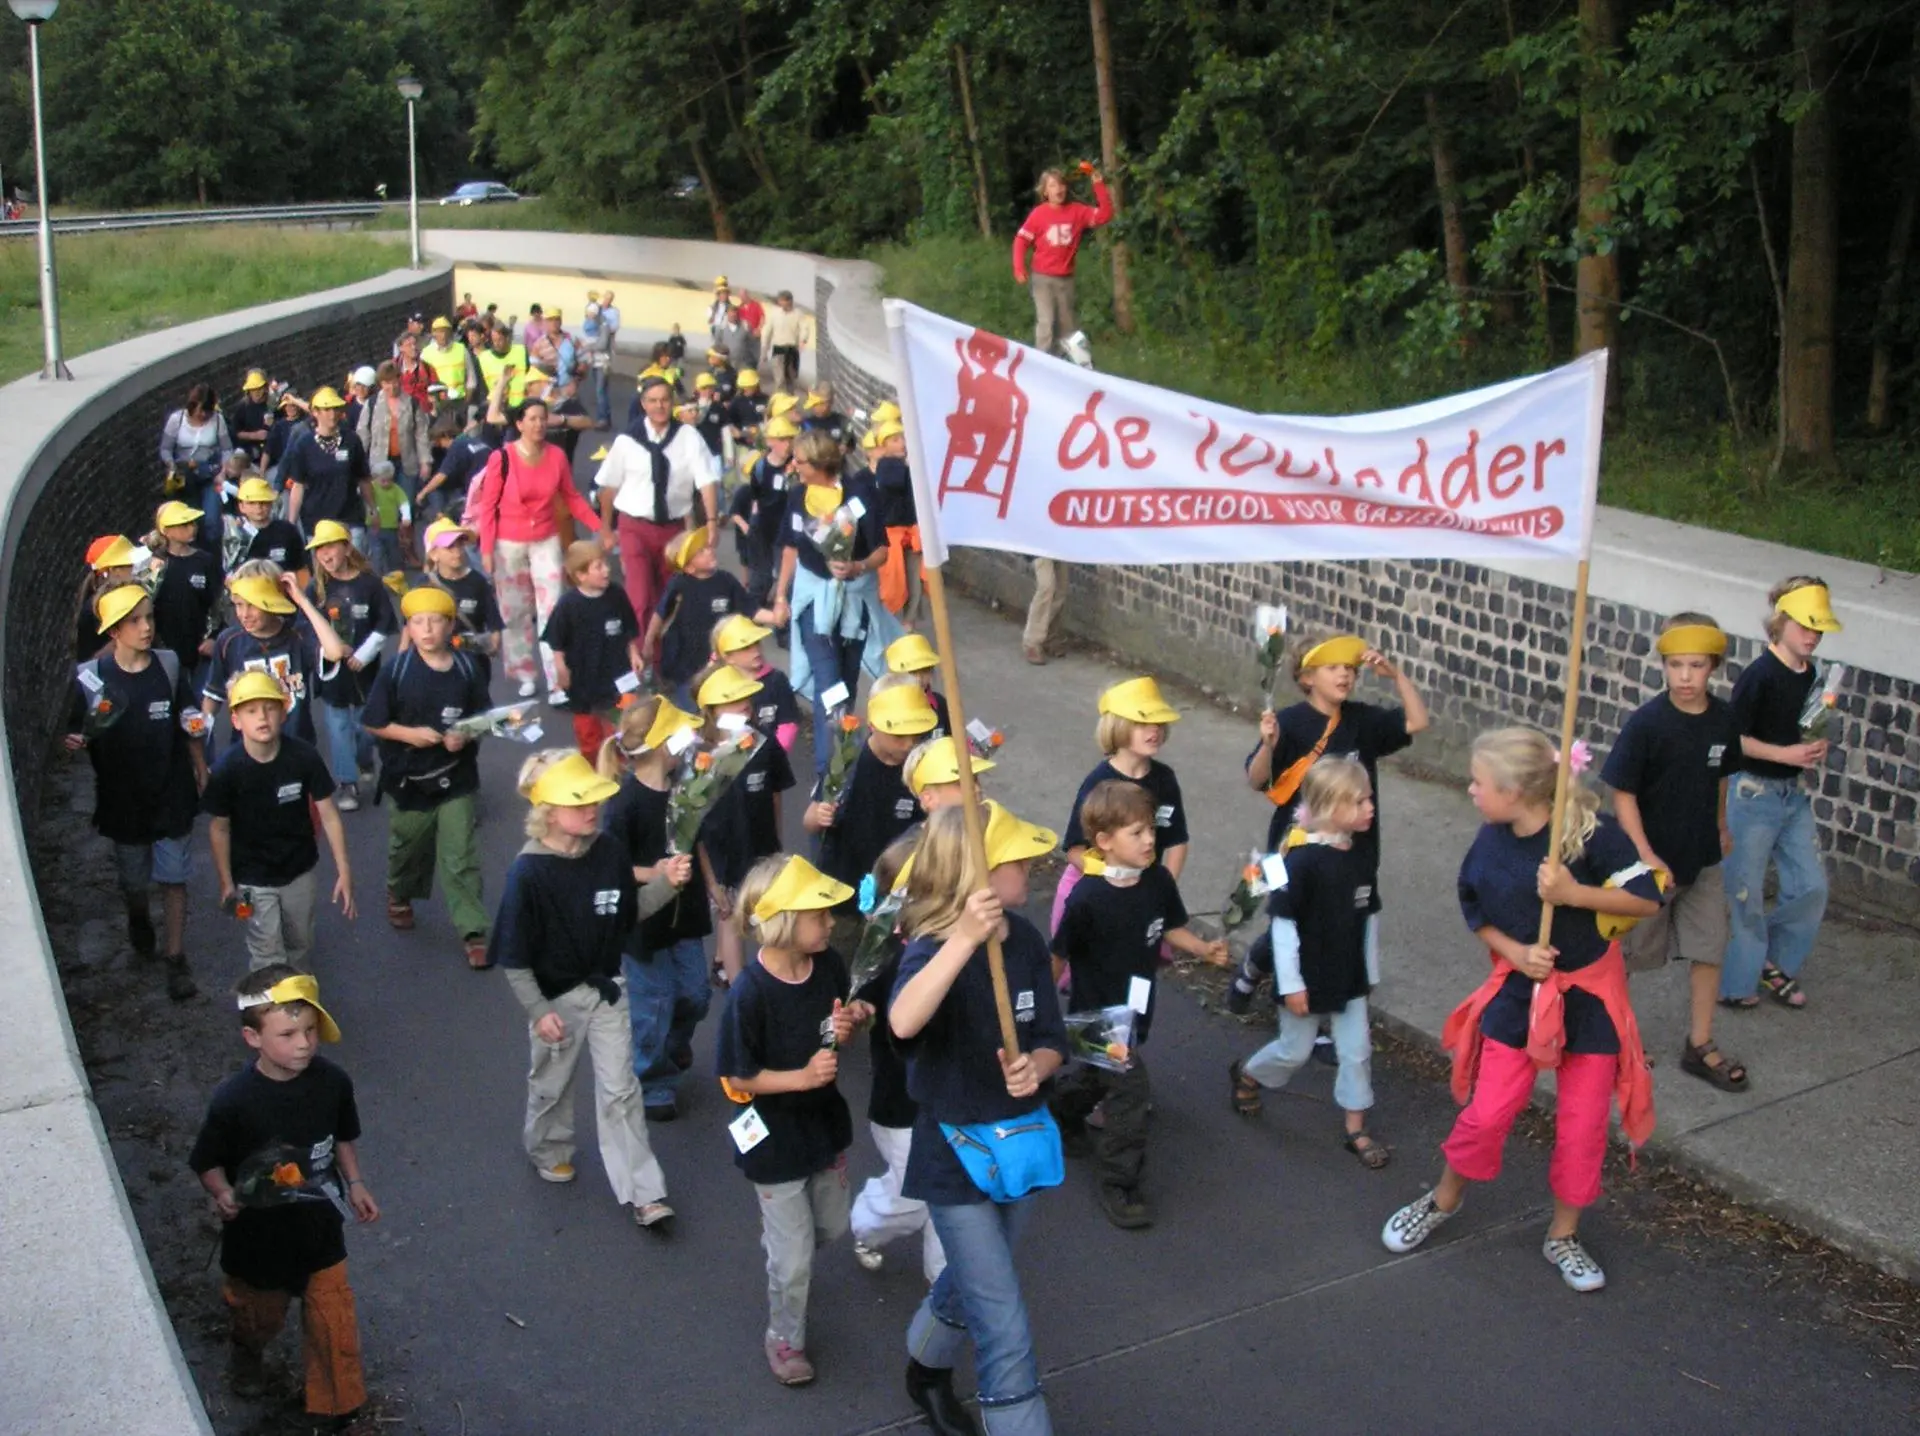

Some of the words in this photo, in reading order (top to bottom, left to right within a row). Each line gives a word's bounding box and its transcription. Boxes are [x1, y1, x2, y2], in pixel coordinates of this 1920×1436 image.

[1046, 223, 1072, 247] 45
[1057, 390, 1157, 471] de
[1065, 493, 1275, 523] NUTSSCHOOL
[1277, 498, 1347, 521] VOOR
